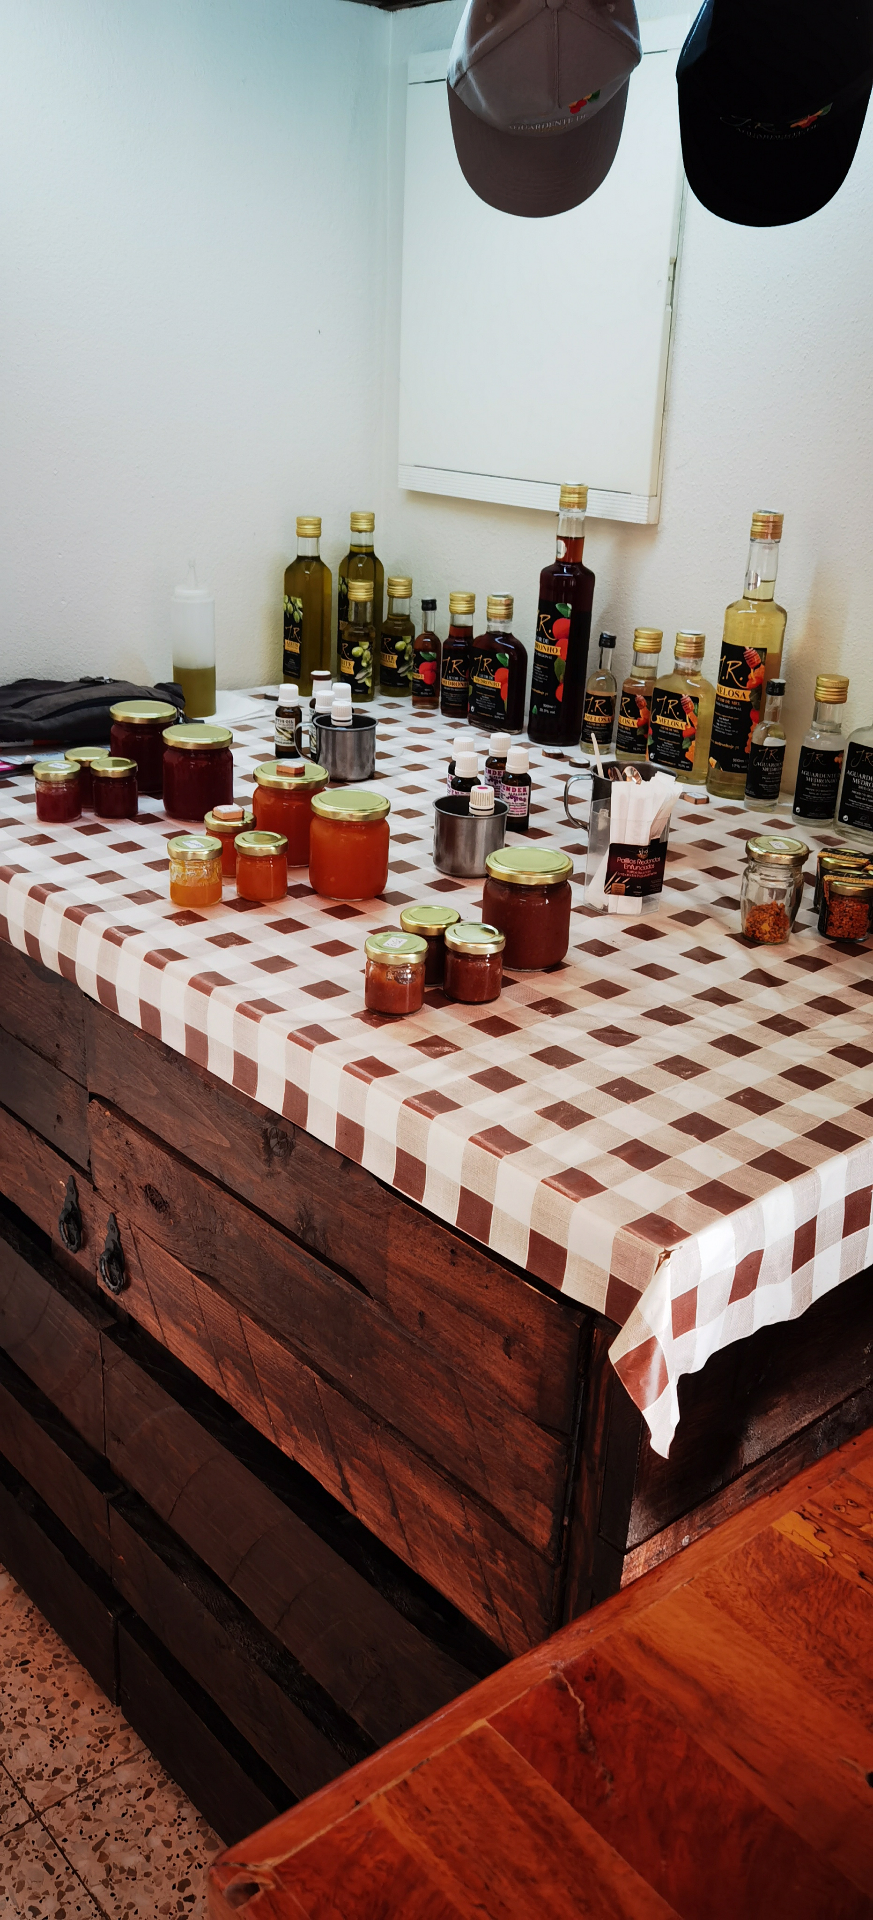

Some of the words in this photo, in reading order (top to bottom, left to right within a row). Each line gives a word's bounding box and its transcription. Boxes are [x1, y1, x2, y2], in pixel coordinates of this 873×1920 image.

[619, 716, 635, 728] LOSA
[657, 716, 684, 730] MELOSA
[502, 784, 527, 793] ENDER
